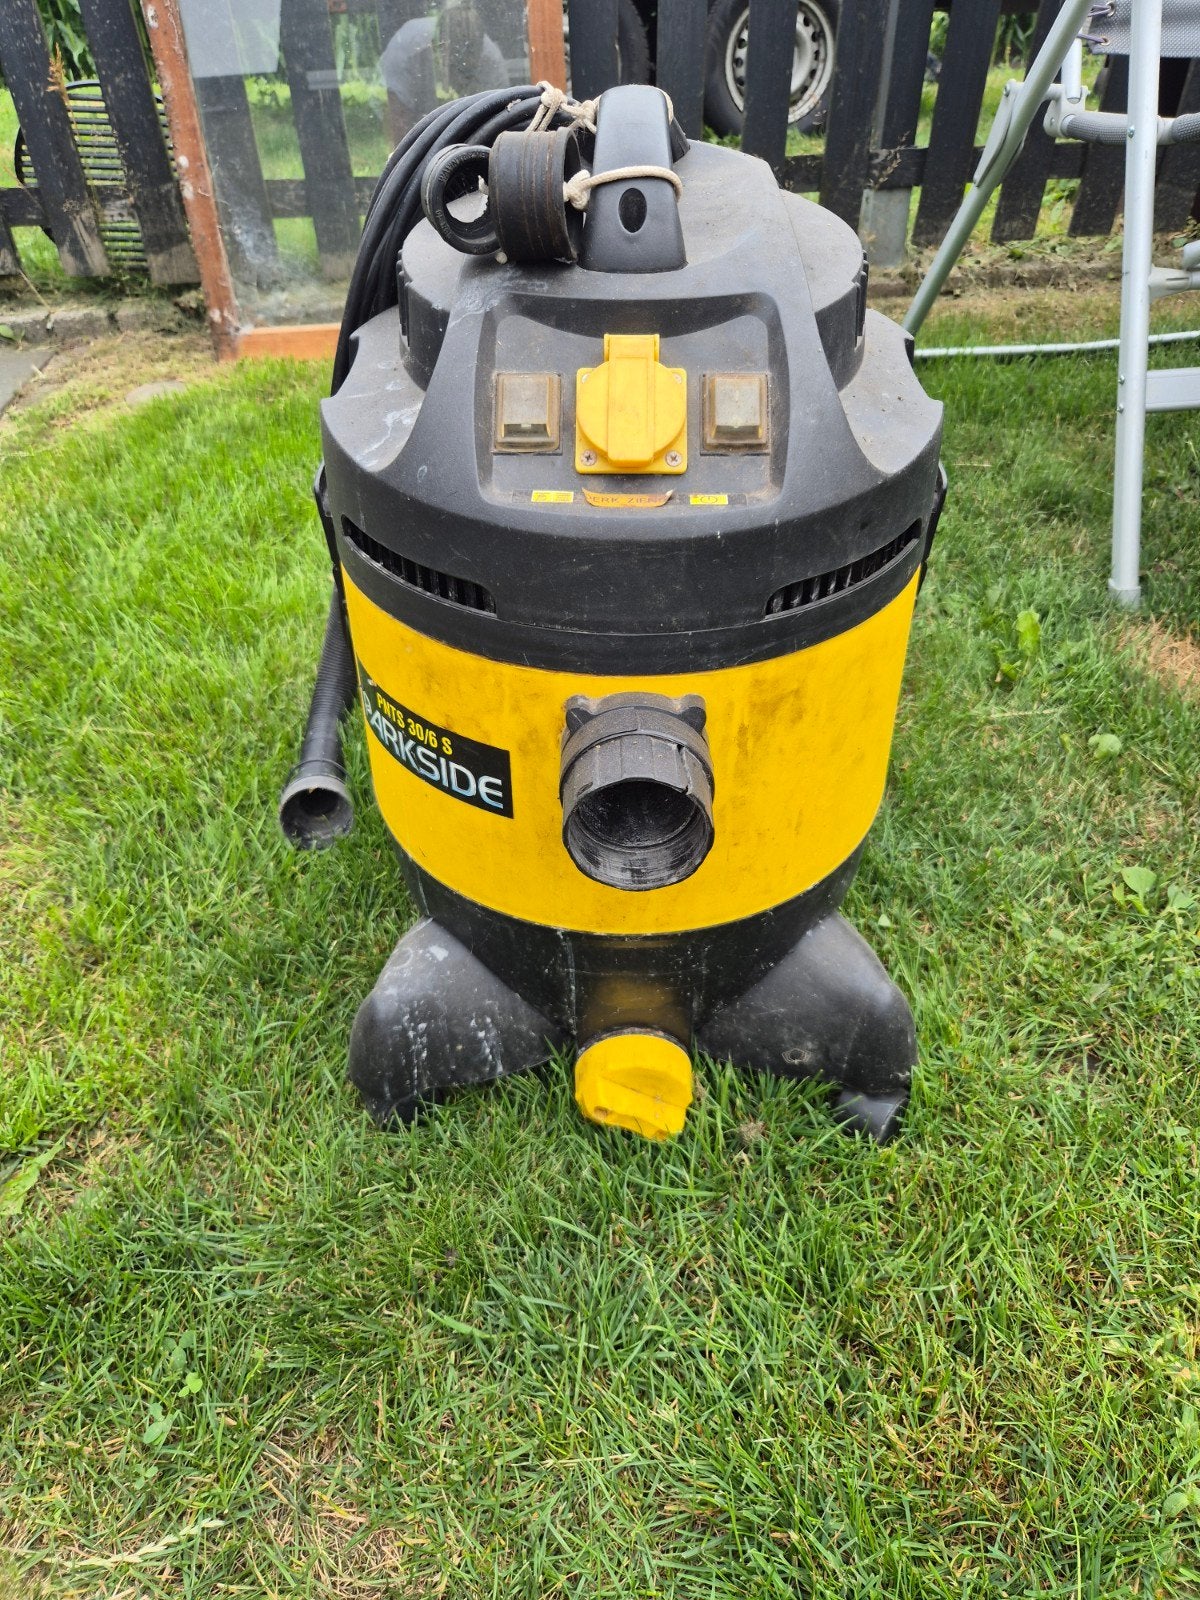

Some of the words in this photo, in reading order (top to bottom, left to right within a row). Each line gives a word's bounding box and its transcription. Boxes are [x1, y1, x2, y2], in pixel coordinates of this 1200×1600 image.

[376, 691, 405, 729] PNTS
[407, 718, 438, 749] 30/6
[441, 736, 453, 755] S
